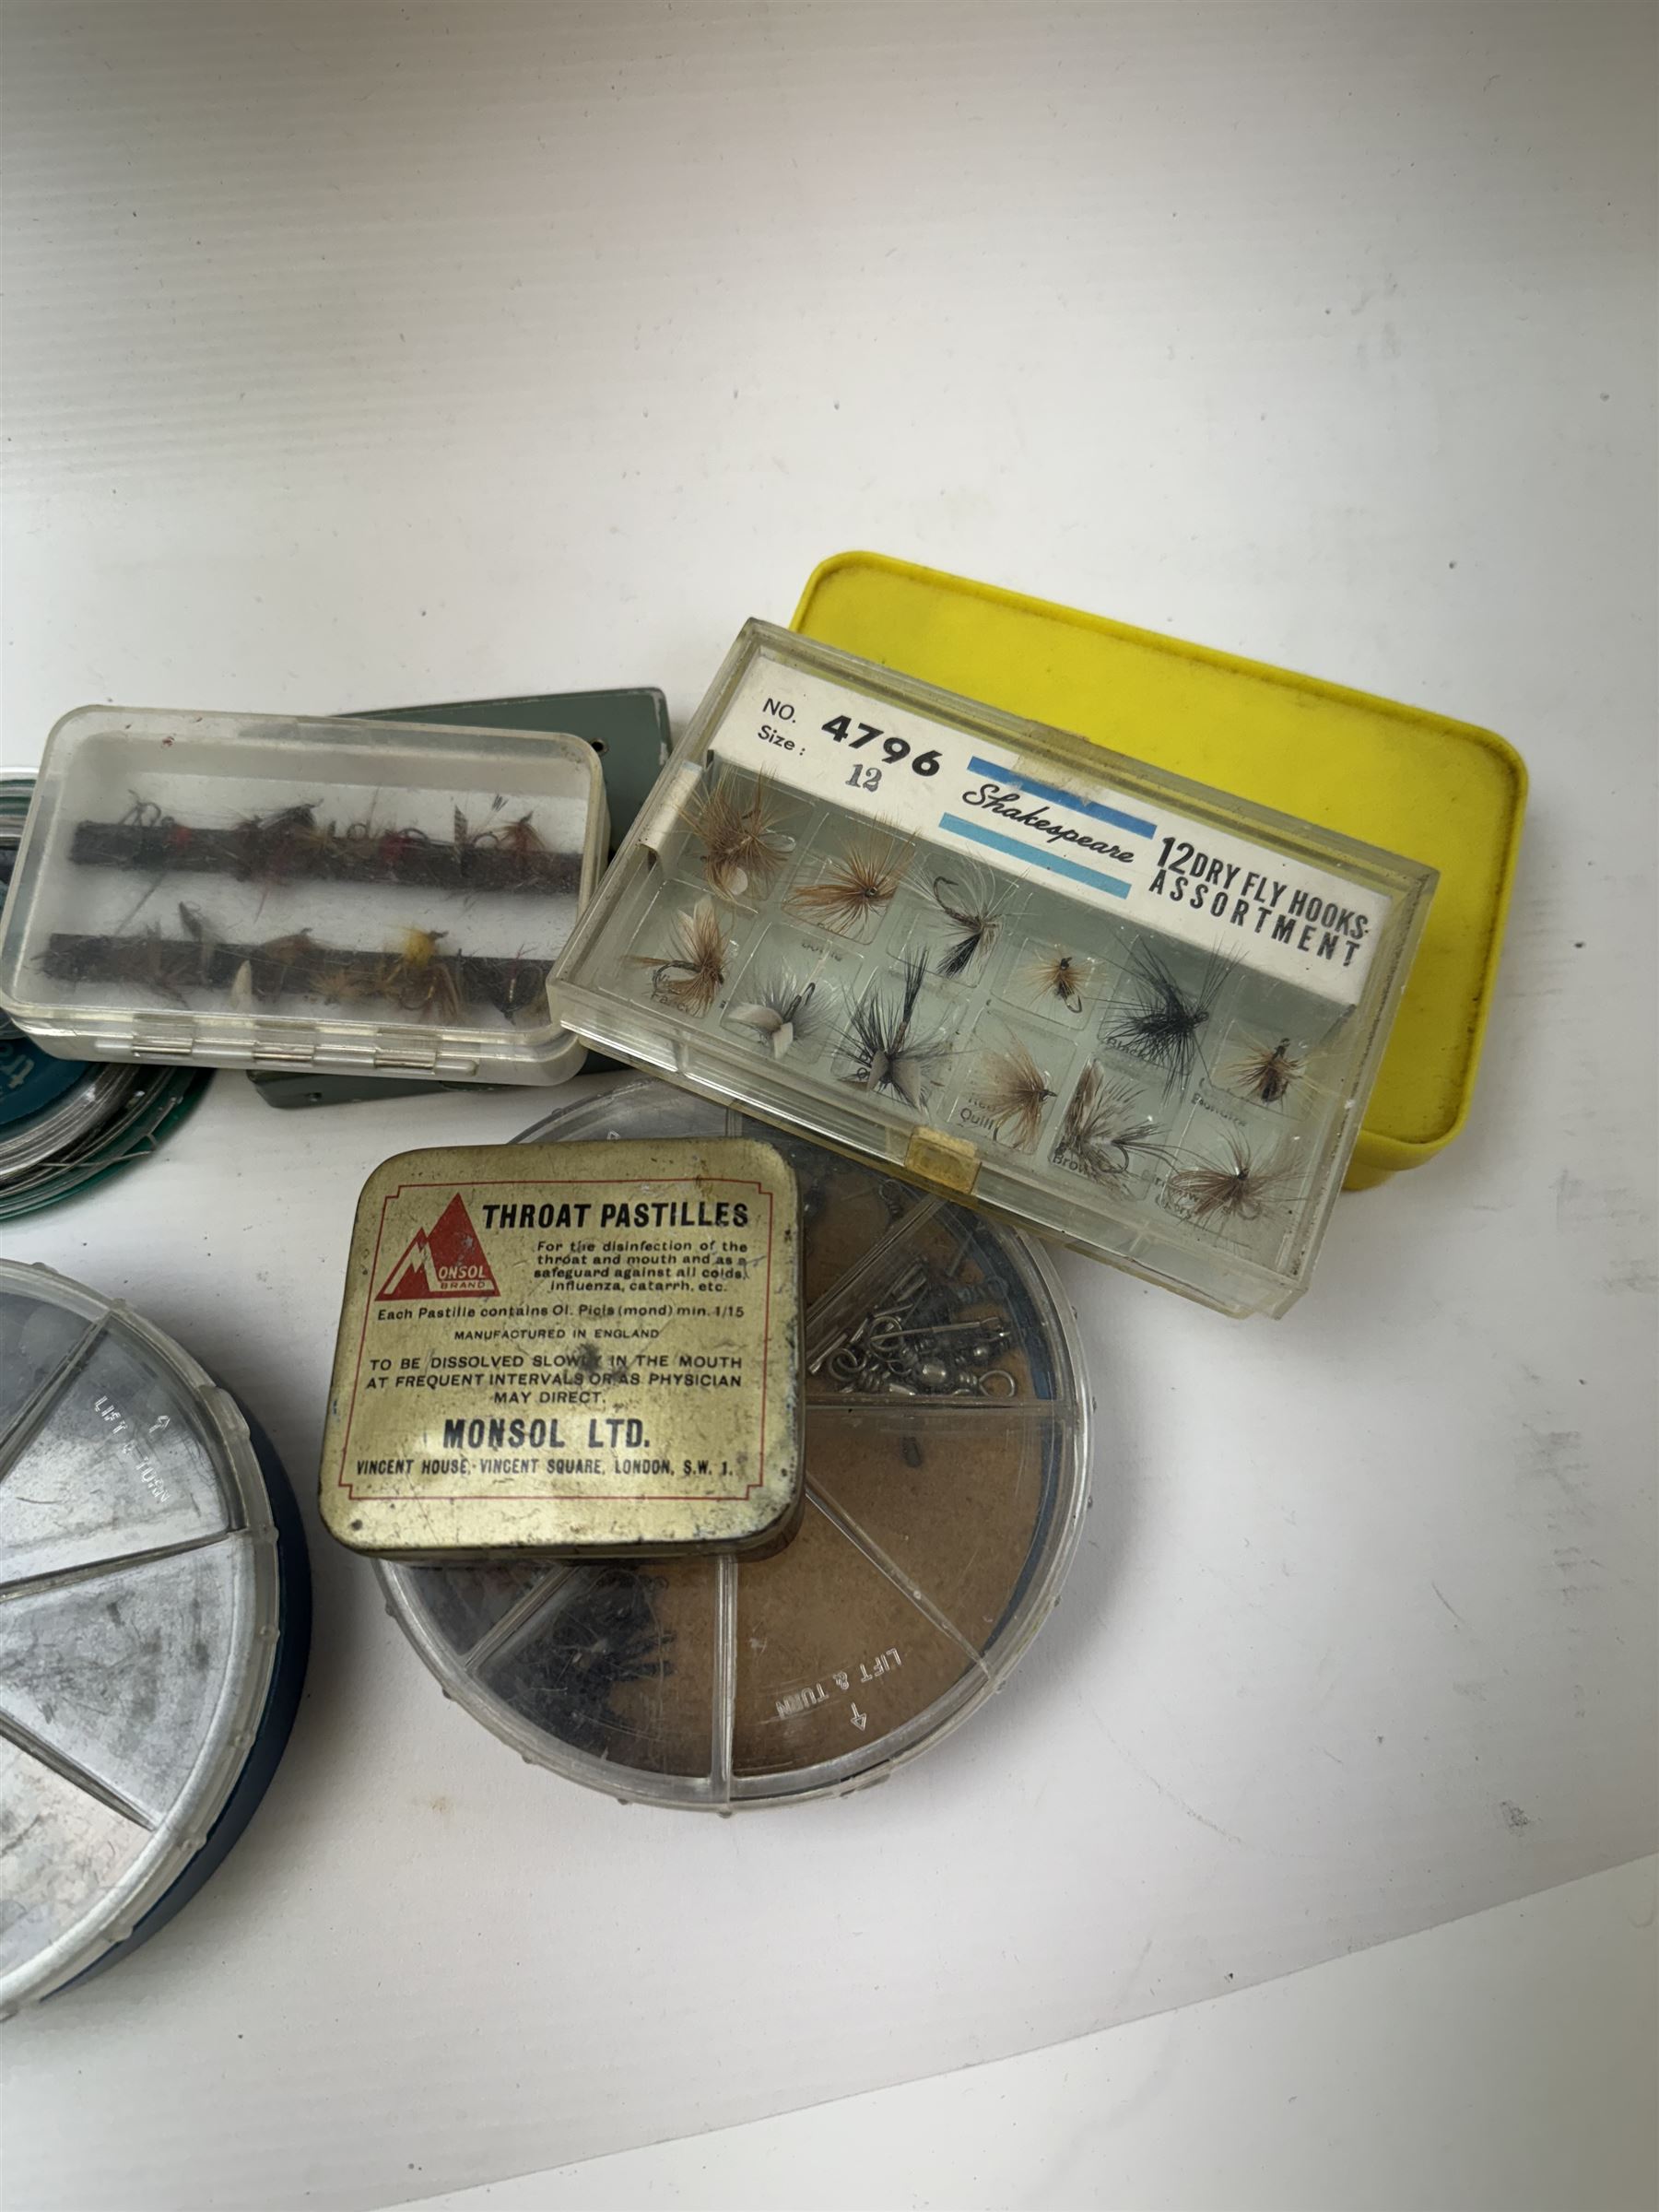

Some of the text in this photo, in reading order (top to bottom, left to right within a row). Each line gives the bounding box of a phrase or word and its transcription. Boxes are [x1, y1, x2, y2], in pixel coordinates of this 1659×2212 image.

[761, 698, 943, 777] NO. 4796
[845, 764, 882, 793] 12
[962, 783, 1134, 864] Shakespeare
[1241, 872, 1288, 908] FLY
[1148, 869, 1360, 966] ASSORTMENT
[960, 1107, 994, 1131] Quill
[483, 1202, 748, 1229] THROAT PASTILLES
[537, 1241, 563, 1252] For
[603, 1241, 692, 1252] disinfection
[700, 1241, 715, 1252] of
[723, 1241, 747, 1253] the
[537, 1254, 587, 1265] throat
[593, 1254, 621, 1265] and
[627, 1254, 677, 1265] mouth
[683, 1254, 711, 1265] and
[715, 1256, 733, 1265] as
[534, 1267, 609, 1279] safeguard
[615, 1267, 672, 1279] against
[676, 1267, 696, 1277] all
[441, 1280, 486, 1289] BRAND
[550, 1281, 625, 1292] influenza,
[699, 1282, 727, 1292] etc.
[378, 1309, 413, 1321] Each
[418, 1307, 476, 1319] Pastille
[480, 1305, 548, 1316] contains
[618, 1305, 673, 1317] (mond)
[677, 1307, 711, 1317] min.
[713, 1307, 745, 1318] 1/15
[454, 1329, 660, 1340] MANUFACTURED IN ENGLAND
[370, 1359, 392, 1371] TO
[400, 1358, 421, 1370] BE
[430, 1356, 524, 1369] DISSOLVED
[610, 1355, 627, 1367] IN
[635, 1355, 669, 1367] THE
[679, 1356, 742, 1369] MOUTH
[366, 1373, 742, 1390] AT FREQUENT INTERVALS OR AS PHYSICIAN
[494, 1392, 606, 1404] MAY DIRECT.
[443, 1418, 650, 1449] MONSOL LTD.
[94, 1395, 127, 1434] LIFT
[135, 1456, 170, 1502] TURN
[357, 1459, 414, 1475] VINCENT
[421, 1459, 471, 1476] HOUSE,
[480, 1459, 539, 1475] VINCENT
[547, 1459, 606, 1476] SQUARE,
[615, 1459, 675, 1477] LONDON,
[775, 1648, 901, 1719] LIFT & TURN
